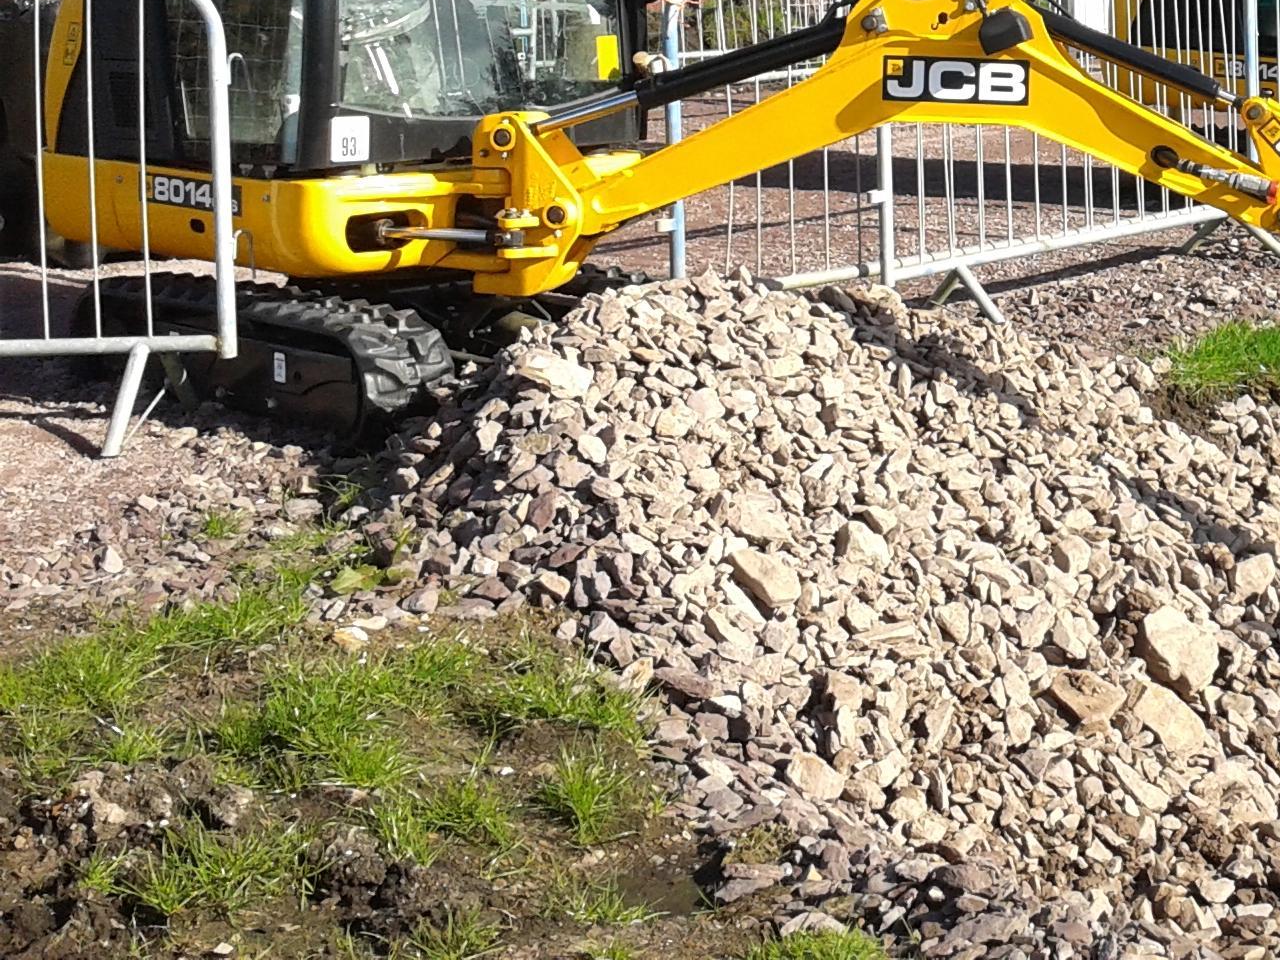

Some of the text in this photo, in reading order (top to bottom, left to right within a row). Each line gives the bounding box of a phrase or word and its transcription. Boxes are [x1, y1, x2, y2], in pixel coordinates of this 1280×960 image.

[887, 60, 1026, 102] JCB
[1229, 60, 1280, 81] 814
[342, 136, 357, 157] 93
[154, 177, 212, 209] 8014
